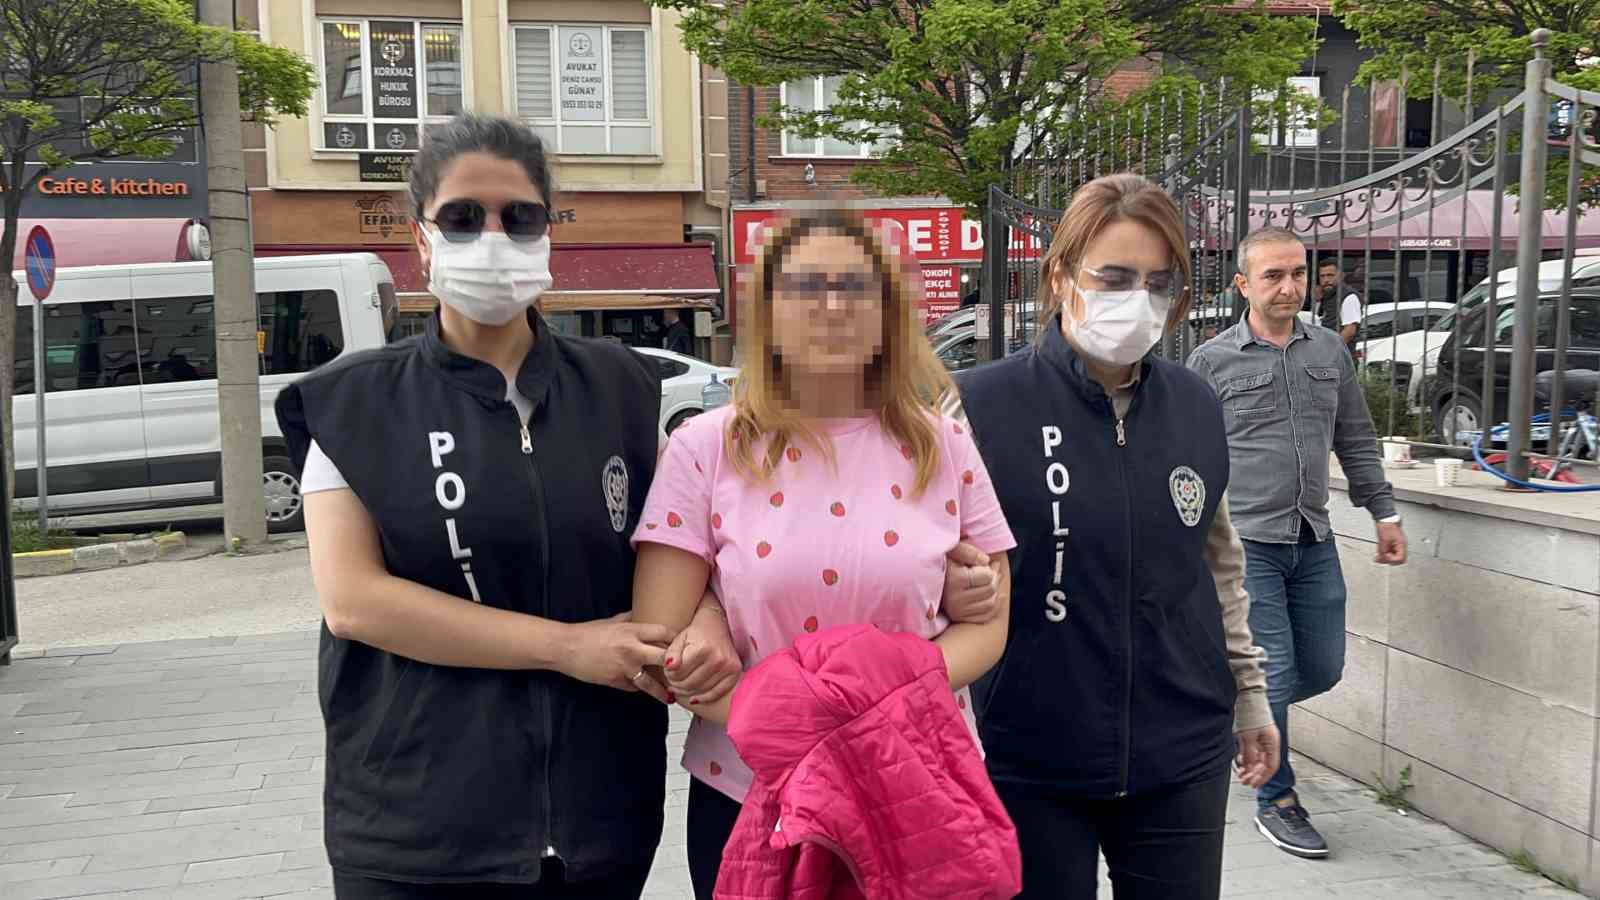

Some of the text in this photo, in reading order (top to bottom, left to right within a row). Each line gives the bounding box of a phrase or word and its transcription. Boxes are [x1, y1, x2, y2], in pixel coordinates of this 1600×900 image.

[374, 67, 414, 77] KORKMAZ
[566, 63, 597, 71] AVUKAT
[380, 82, 408, 91] HUKUK
[568, 85, 595, 95] GÜNAY
[379, 95, 411, 106] BÜROSU
[38, 176, 188, 196] Cafe & kitchen
[428, 431, 482, 603] POLİ
[1041, 425, 1071, 622] POLİS
